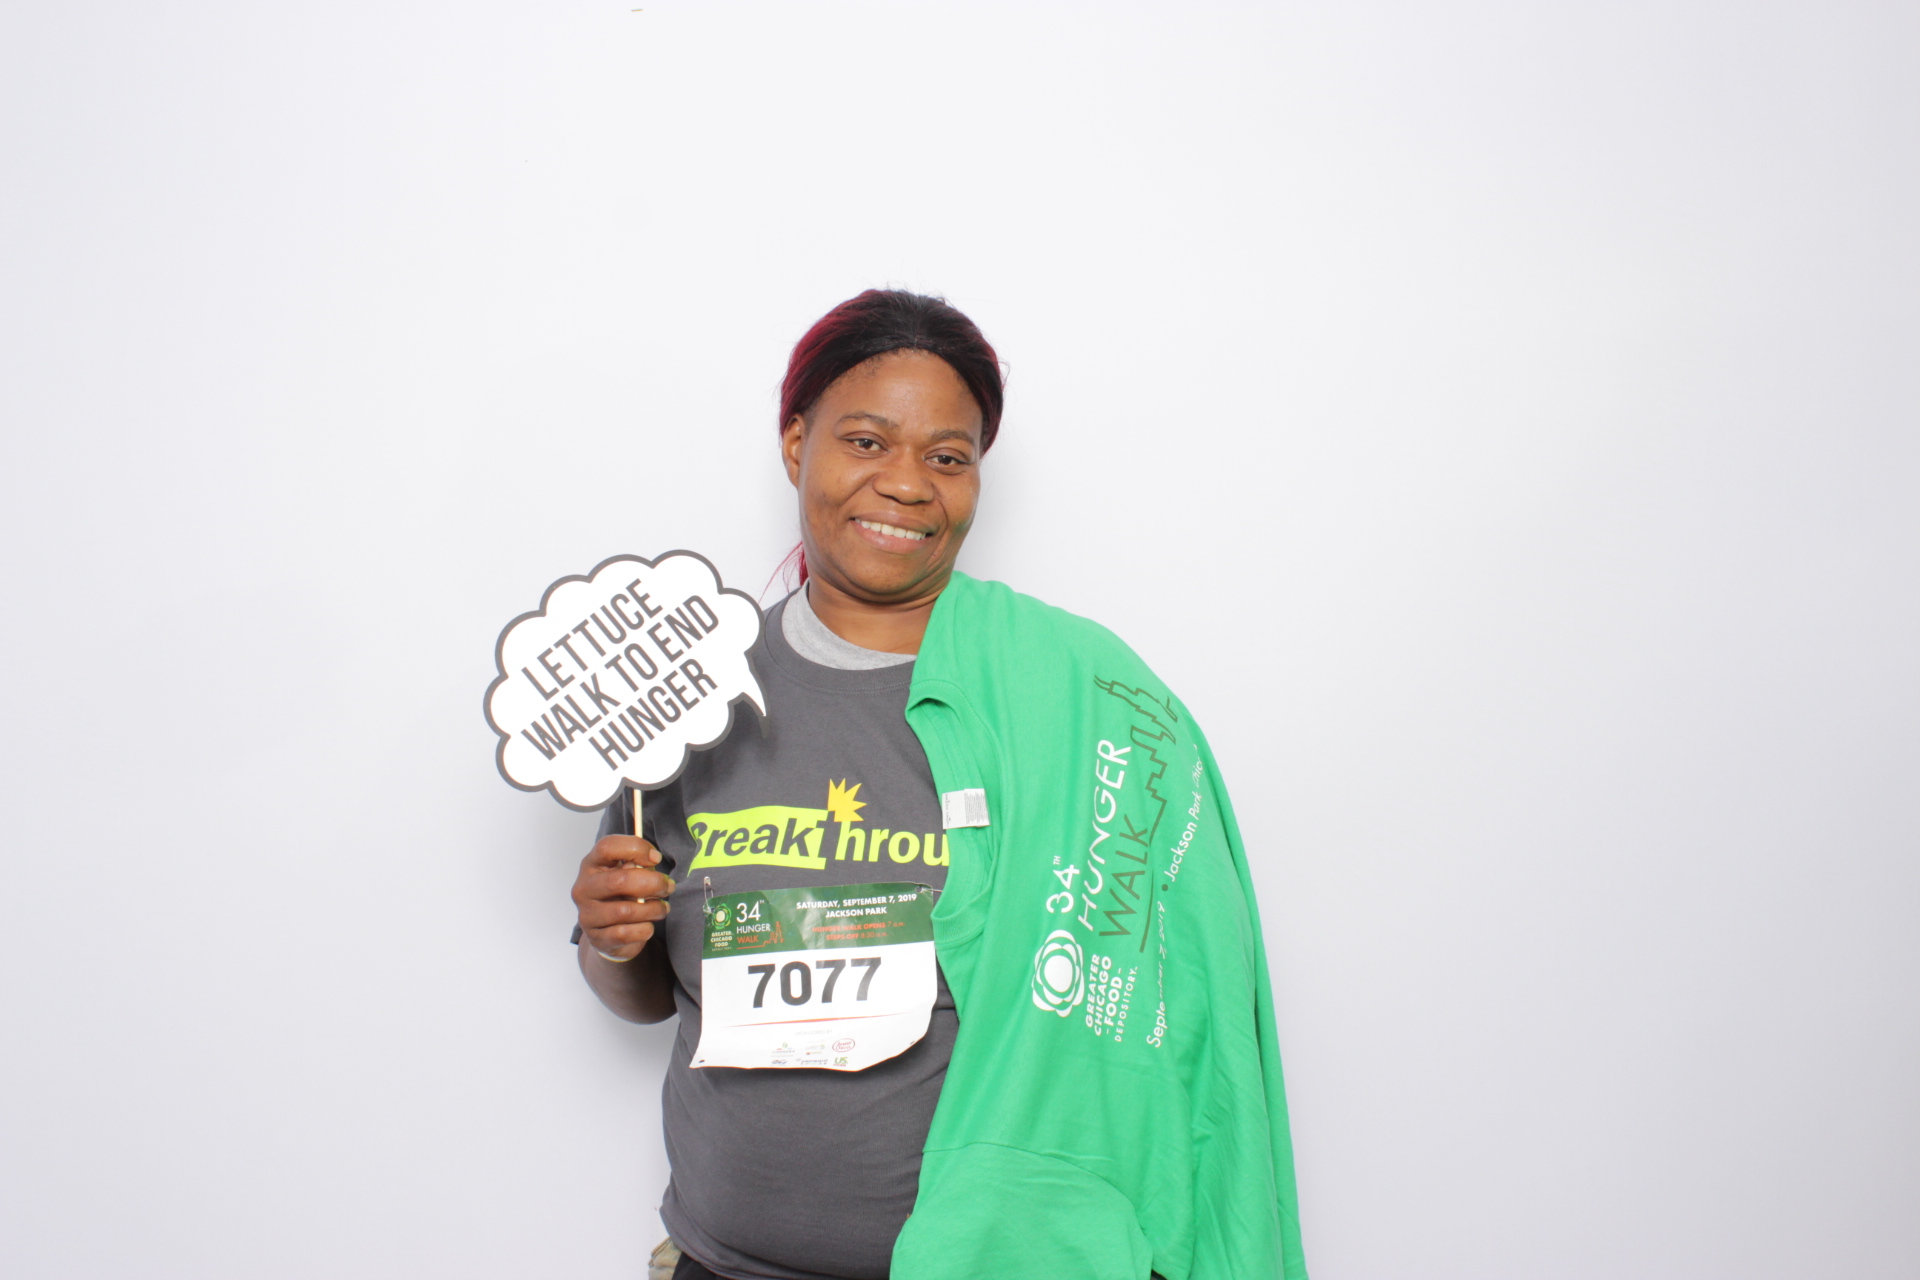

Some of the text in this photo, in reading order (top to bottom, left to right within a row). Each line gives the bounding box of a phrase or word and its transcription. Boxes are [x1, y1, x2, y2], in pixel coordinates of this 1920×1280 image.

[520, 595, 719, 760] WALK TO END
[521, 578, 663, 701] LETTUCE
[588, 659, 718, 771] HUNGER
[1078, 739, 1131, 931] HUNGER
[1164, 822, 1197, 882] Jackson
[1188, 791, 1202, 820] Park
[796, 893, 917, 909] SATURDAY, SEPTEMBER 7, 2019
[825, 906, 887, 918] JACKSON PARK
[1098, 814, 1149, 937] WALK
[736, 923, 771, 934] HUNGER
[736, 935, 759, 944] WALK
[863, 922, 886, 930] OPENS
[747, 957, 881, 1008] 7077
[1085, 954, 1100, 1028] GREATER
[1094, 956, 1112, 1036] CHICAGO
